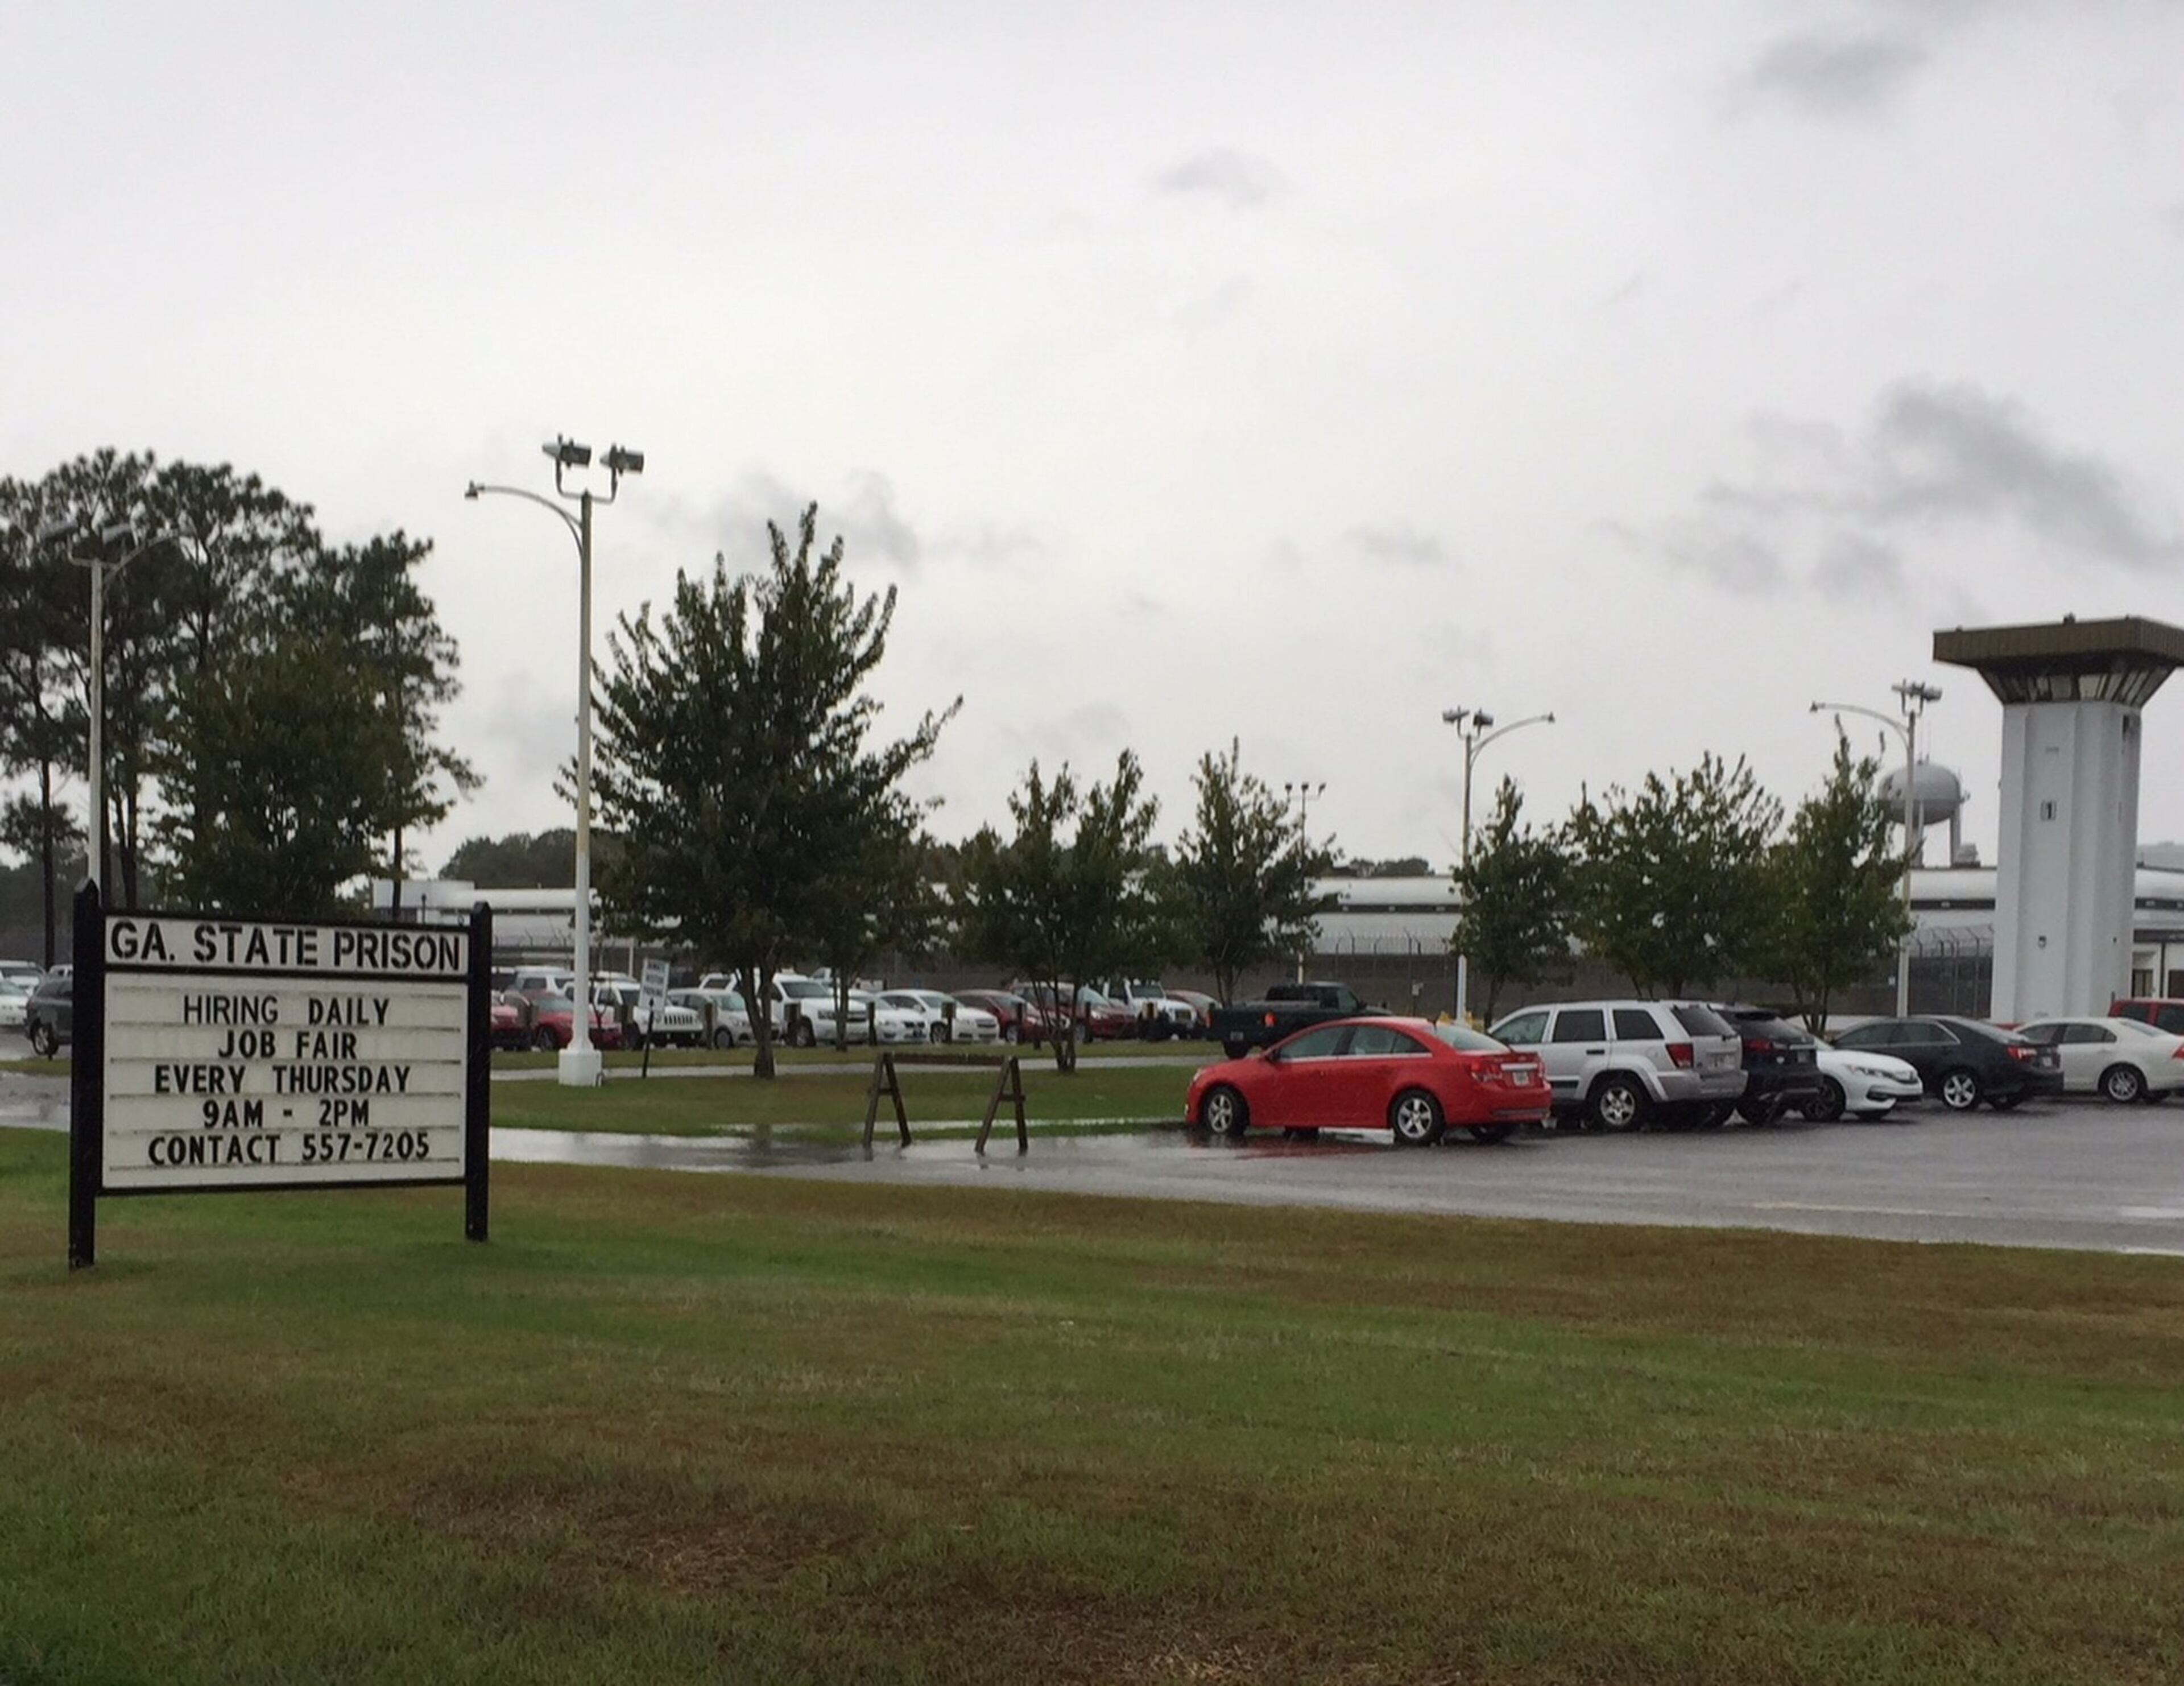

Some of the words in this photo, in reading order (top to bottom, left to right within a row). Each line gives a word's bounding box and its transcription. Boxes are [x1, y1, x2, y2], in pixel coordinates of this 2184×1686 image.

[110, 921, 175, 961] GA.
[193, 922, 318, 966] STATE
[333, 931, 460, 970] PRISON
[184, 995, 278, 1024] HIRING
[308, 998, 390, 1026] DAILY
[218, 1030, 275, 1059] JOB
[295, 1031, 357, 1060] FAIR
[155, 1065, 246, 1094] EVERY
[272, 1065, 411, 1093] THURSDAY
[202, 1100, 263, 1128] 9AM
[319, 1100, 369, 1127] 2PM
[148, 1134, 281, 1166] CONTACT
[302, 1133, 430, 1161] 557-7205
